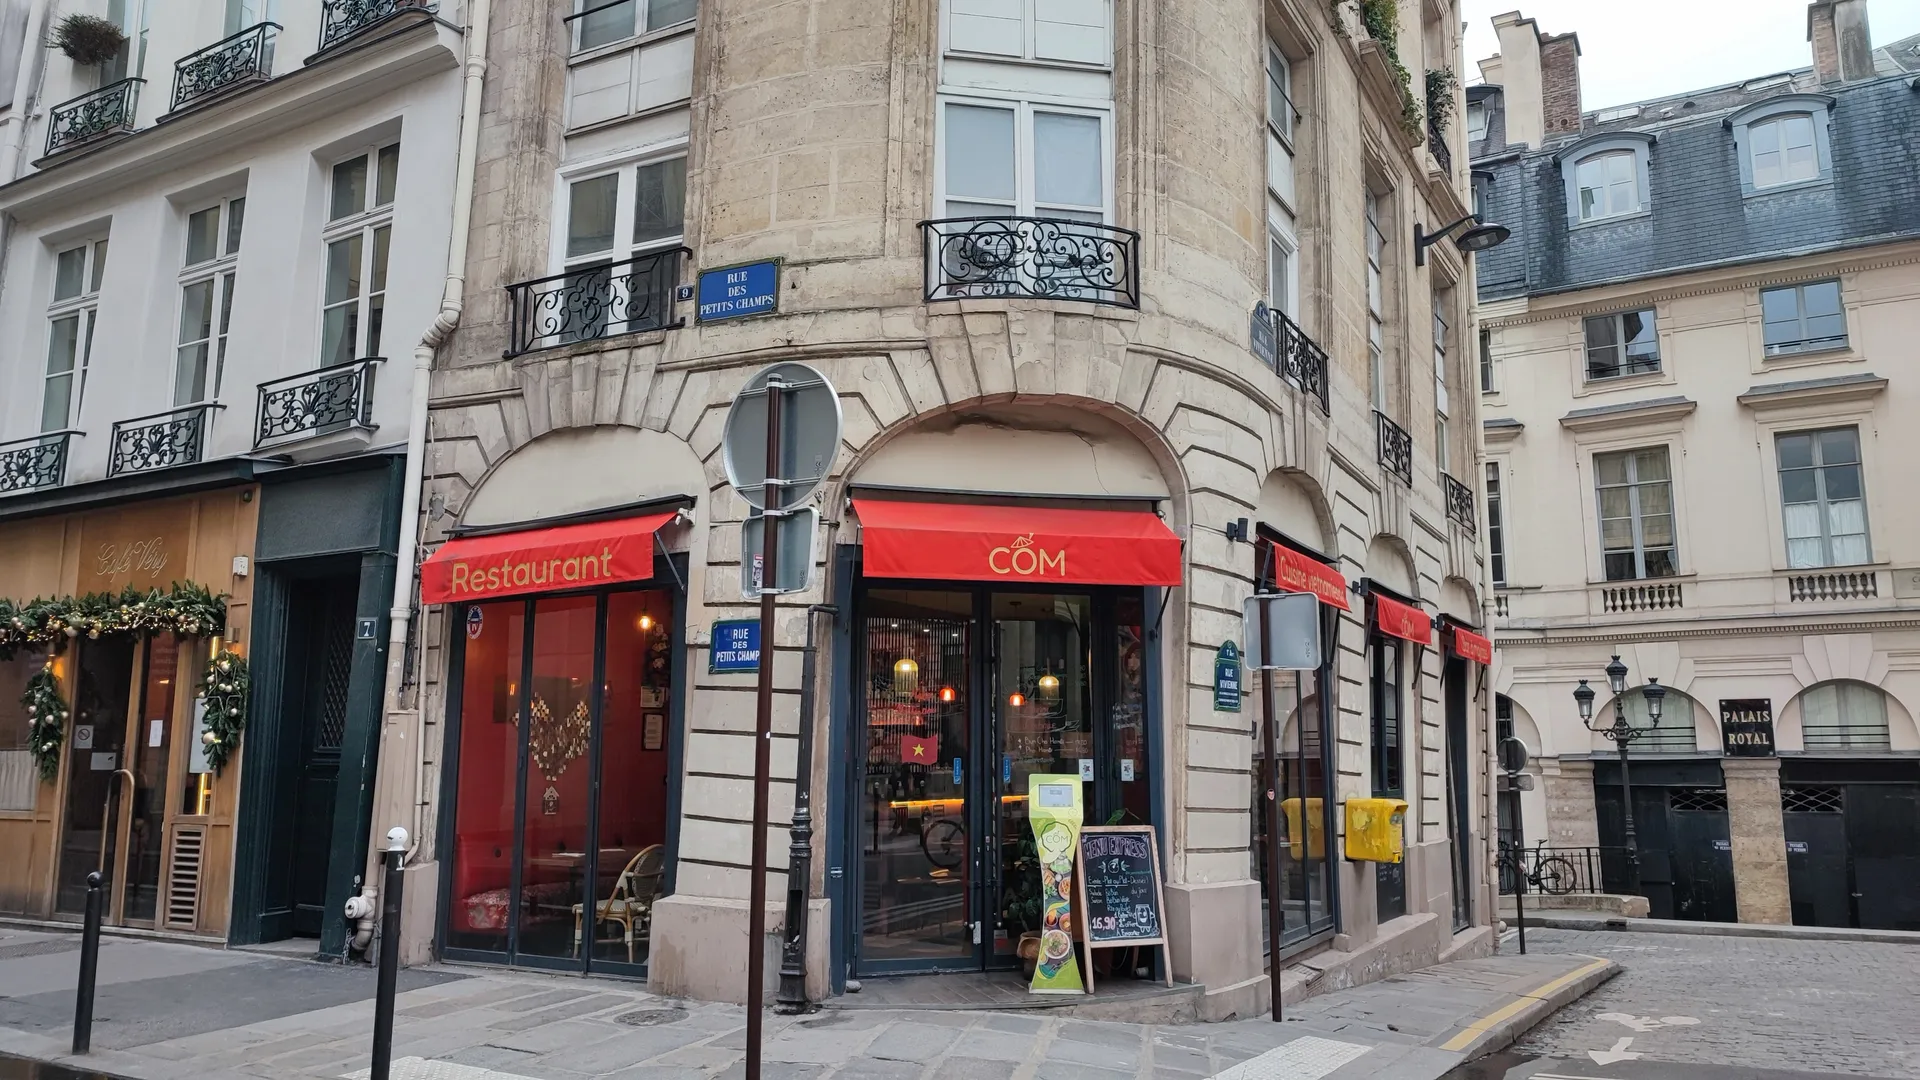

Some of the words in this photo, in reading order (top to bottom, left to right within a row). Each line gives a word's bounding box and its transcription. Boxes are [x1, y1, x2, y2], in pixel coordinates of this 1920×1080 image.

[727, 271, 747, 284] RUE
[682, 288, 688, 298] 9
[728, 285, 746, 297] DES
[700, 301, 733, 315] PETITS
[736, 294, 774, 309] CHAMPS
[452, 547, 613, 594] Restaurant
[1280, 555, 1306, 589] Cuisine
[363, 621, 371, 637] 7
[733, 628, 749, 640] RUE
[732, 641, 748, 649] DES
[716, 651, 736, 662] PETITS
[737, 650, 760, 662] CHAMP
[1225, 668, 1234, 678] RUE
[1722, 710, 1770, 723] PALAIS
[1728, 733, 1770, 745] ROYAL
[1084, 837, 1108, 859] MENU
[1108, 836, 1148, 859] EXPRESS
[1092, 916, 1116, 931] 16,90
